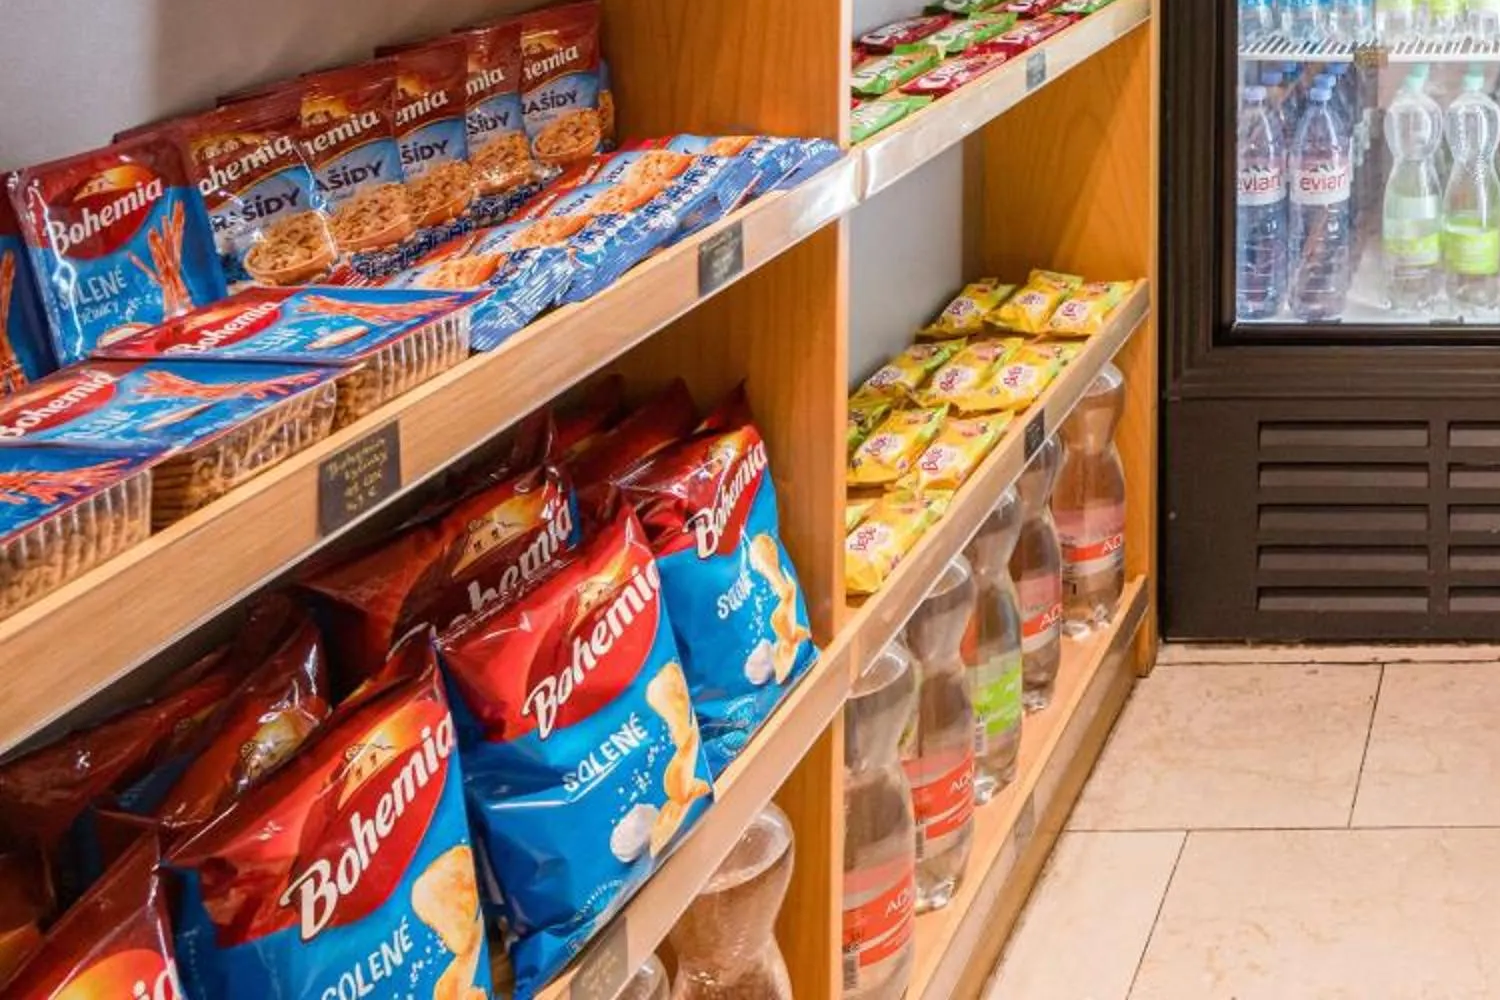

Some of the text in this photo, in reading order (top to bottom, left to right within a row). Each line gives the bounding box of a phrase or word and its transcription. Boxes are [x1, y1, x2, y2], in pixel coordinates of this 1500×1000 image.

[523, 45, 580, 82] hemia
[397, 88, 448, 128] emia
[467, 109, 511, 137] ŠÍDY
[521, 90, 580, 117] RAŠÍDY
[303, 109, 381, 159] hemia
[401, 137, 449, 166] ŠÍDY
[198, 136, 292, 196] ohemia
[315, 159, 385, 196] AŠÍDY
[1301, 173, 1345, 193] evian
[44, 178, 163, 257] Bohemia
[211, 187, 301, 232] RAŠÍDY
[59, 264, 127, 310] SLENÉ
[683, 439, 767, 560] Bohemia
[467, 496, 574, 612] hemia
[522, 559, 660, 740] Bohemia
[279, 711, 454, 942] Bohemia
